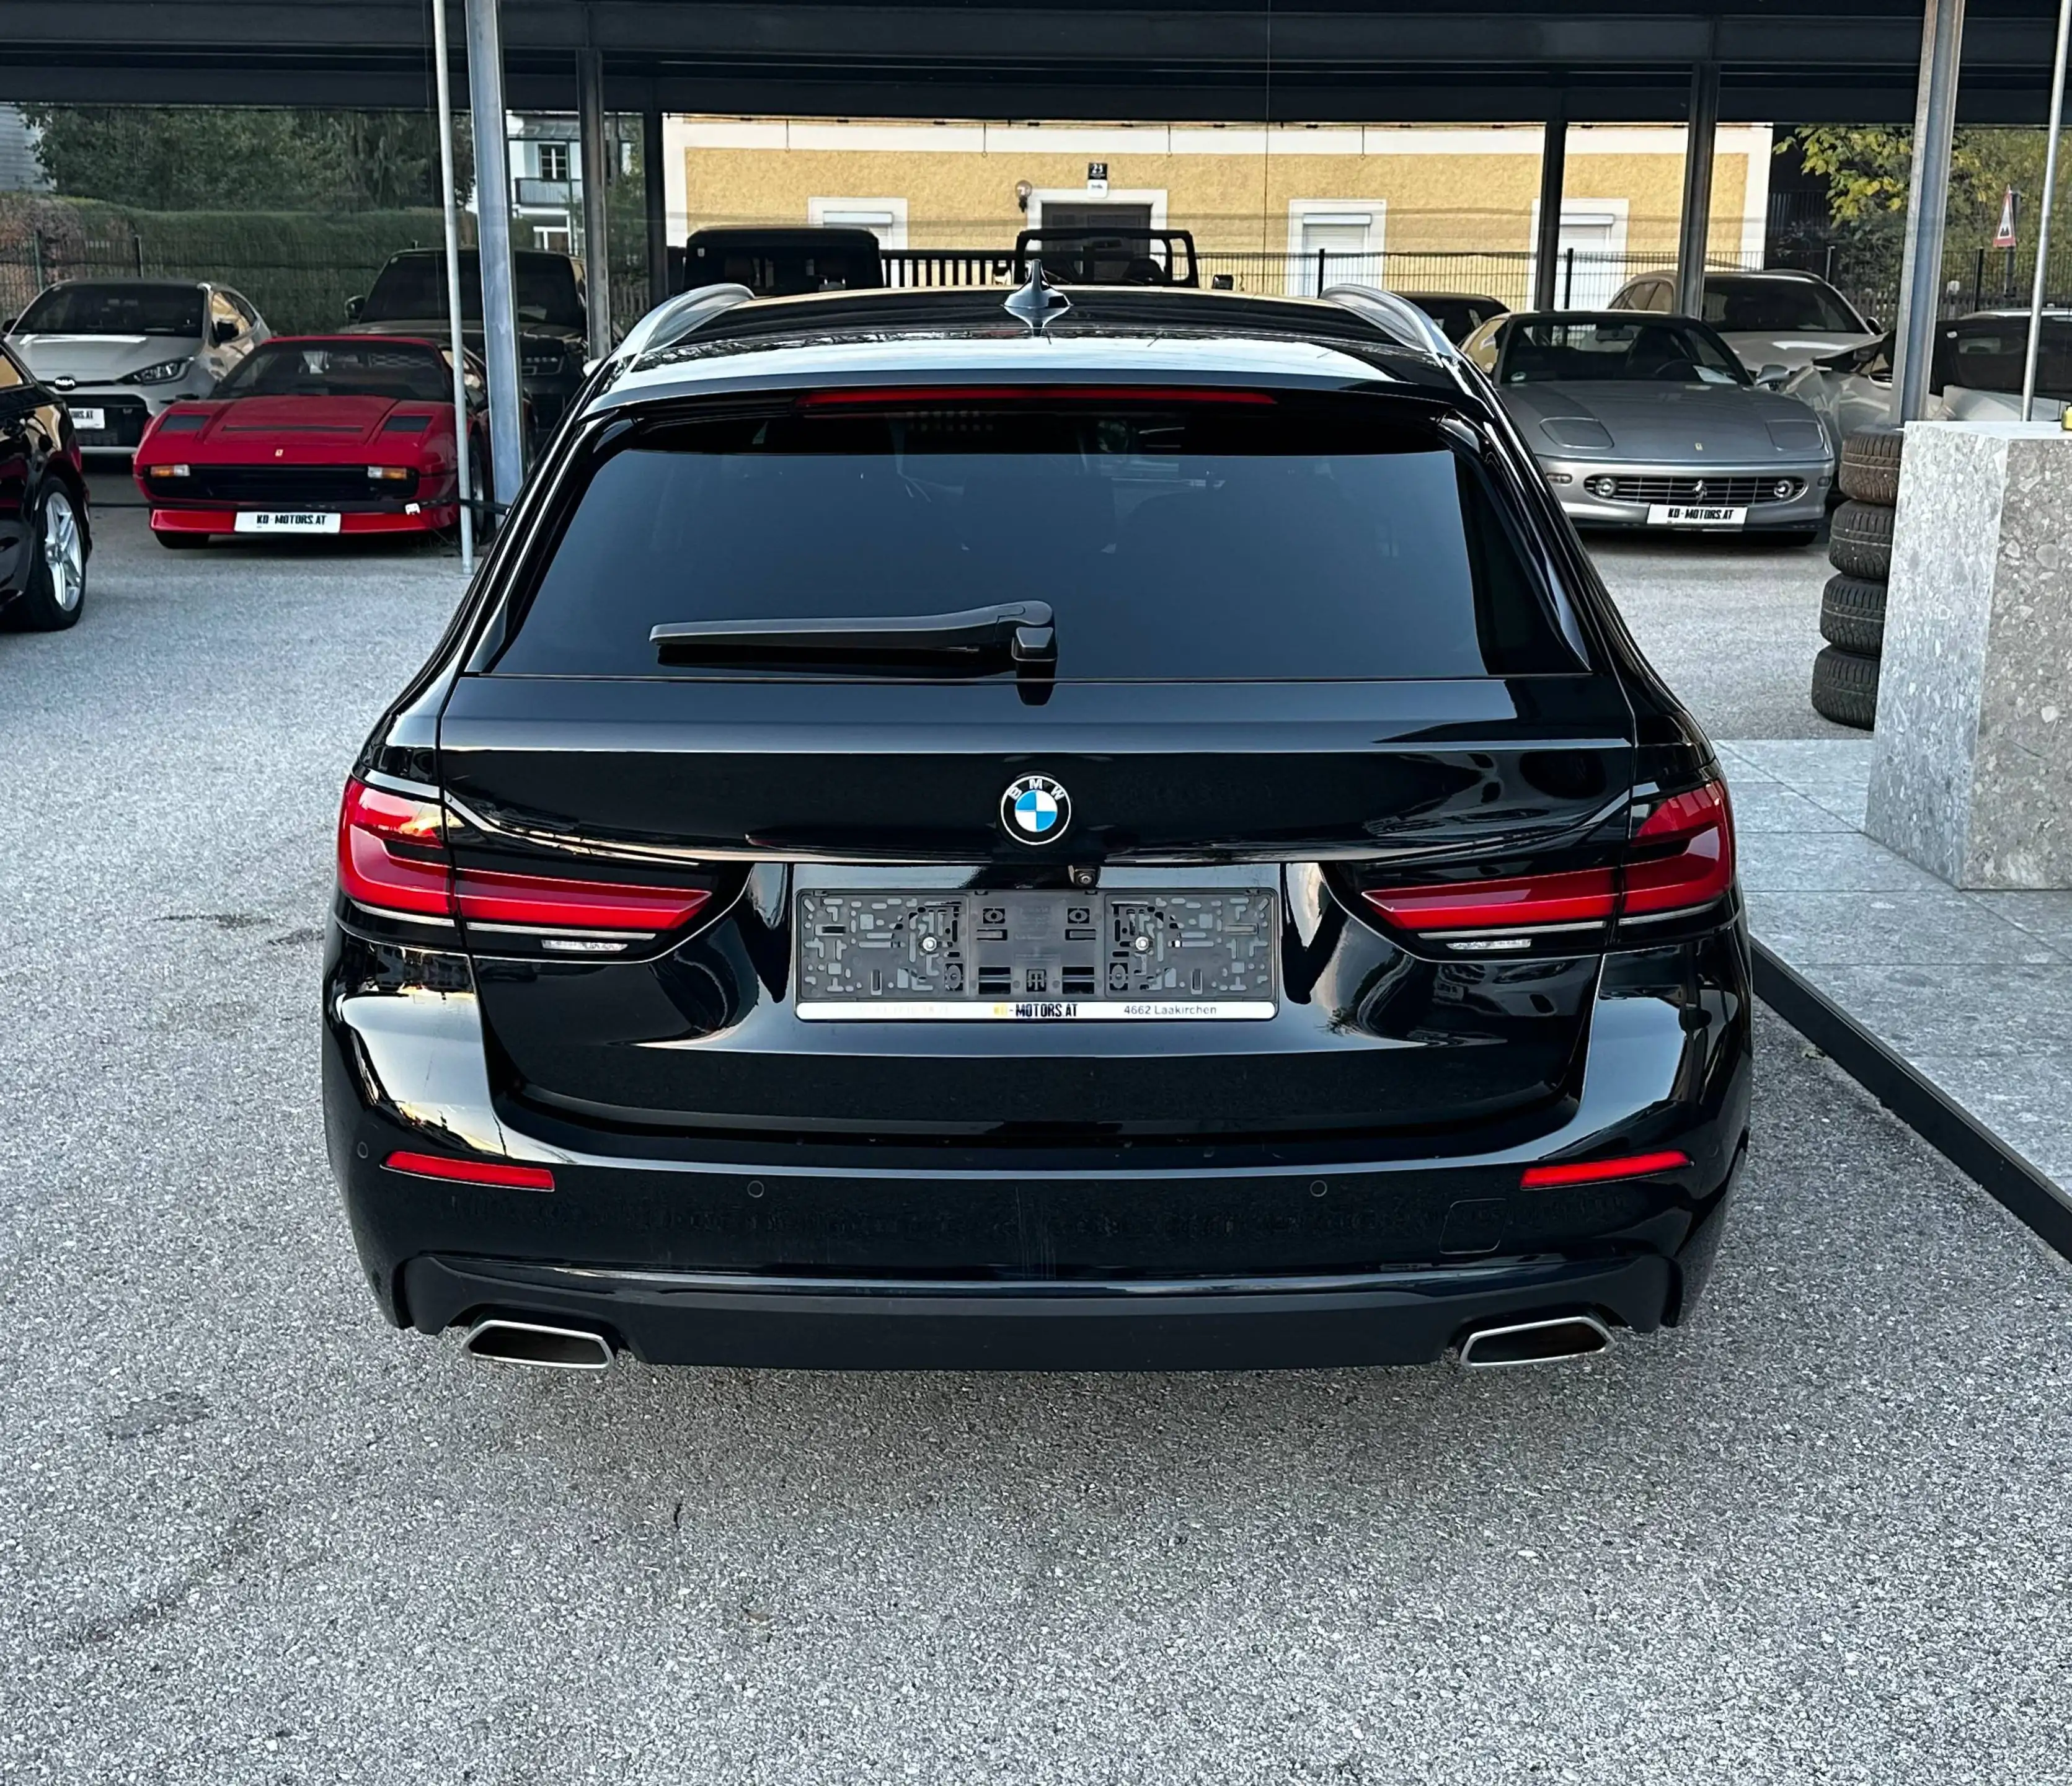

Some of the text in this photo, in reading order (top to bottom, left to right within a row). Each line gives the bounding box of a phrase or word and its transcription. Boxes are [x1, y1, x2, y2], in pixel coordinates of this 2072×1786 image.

[1008, 778, 1065, 801] BMW
[1123, 1005, 1217, 1015] 4662 Laakirchen
